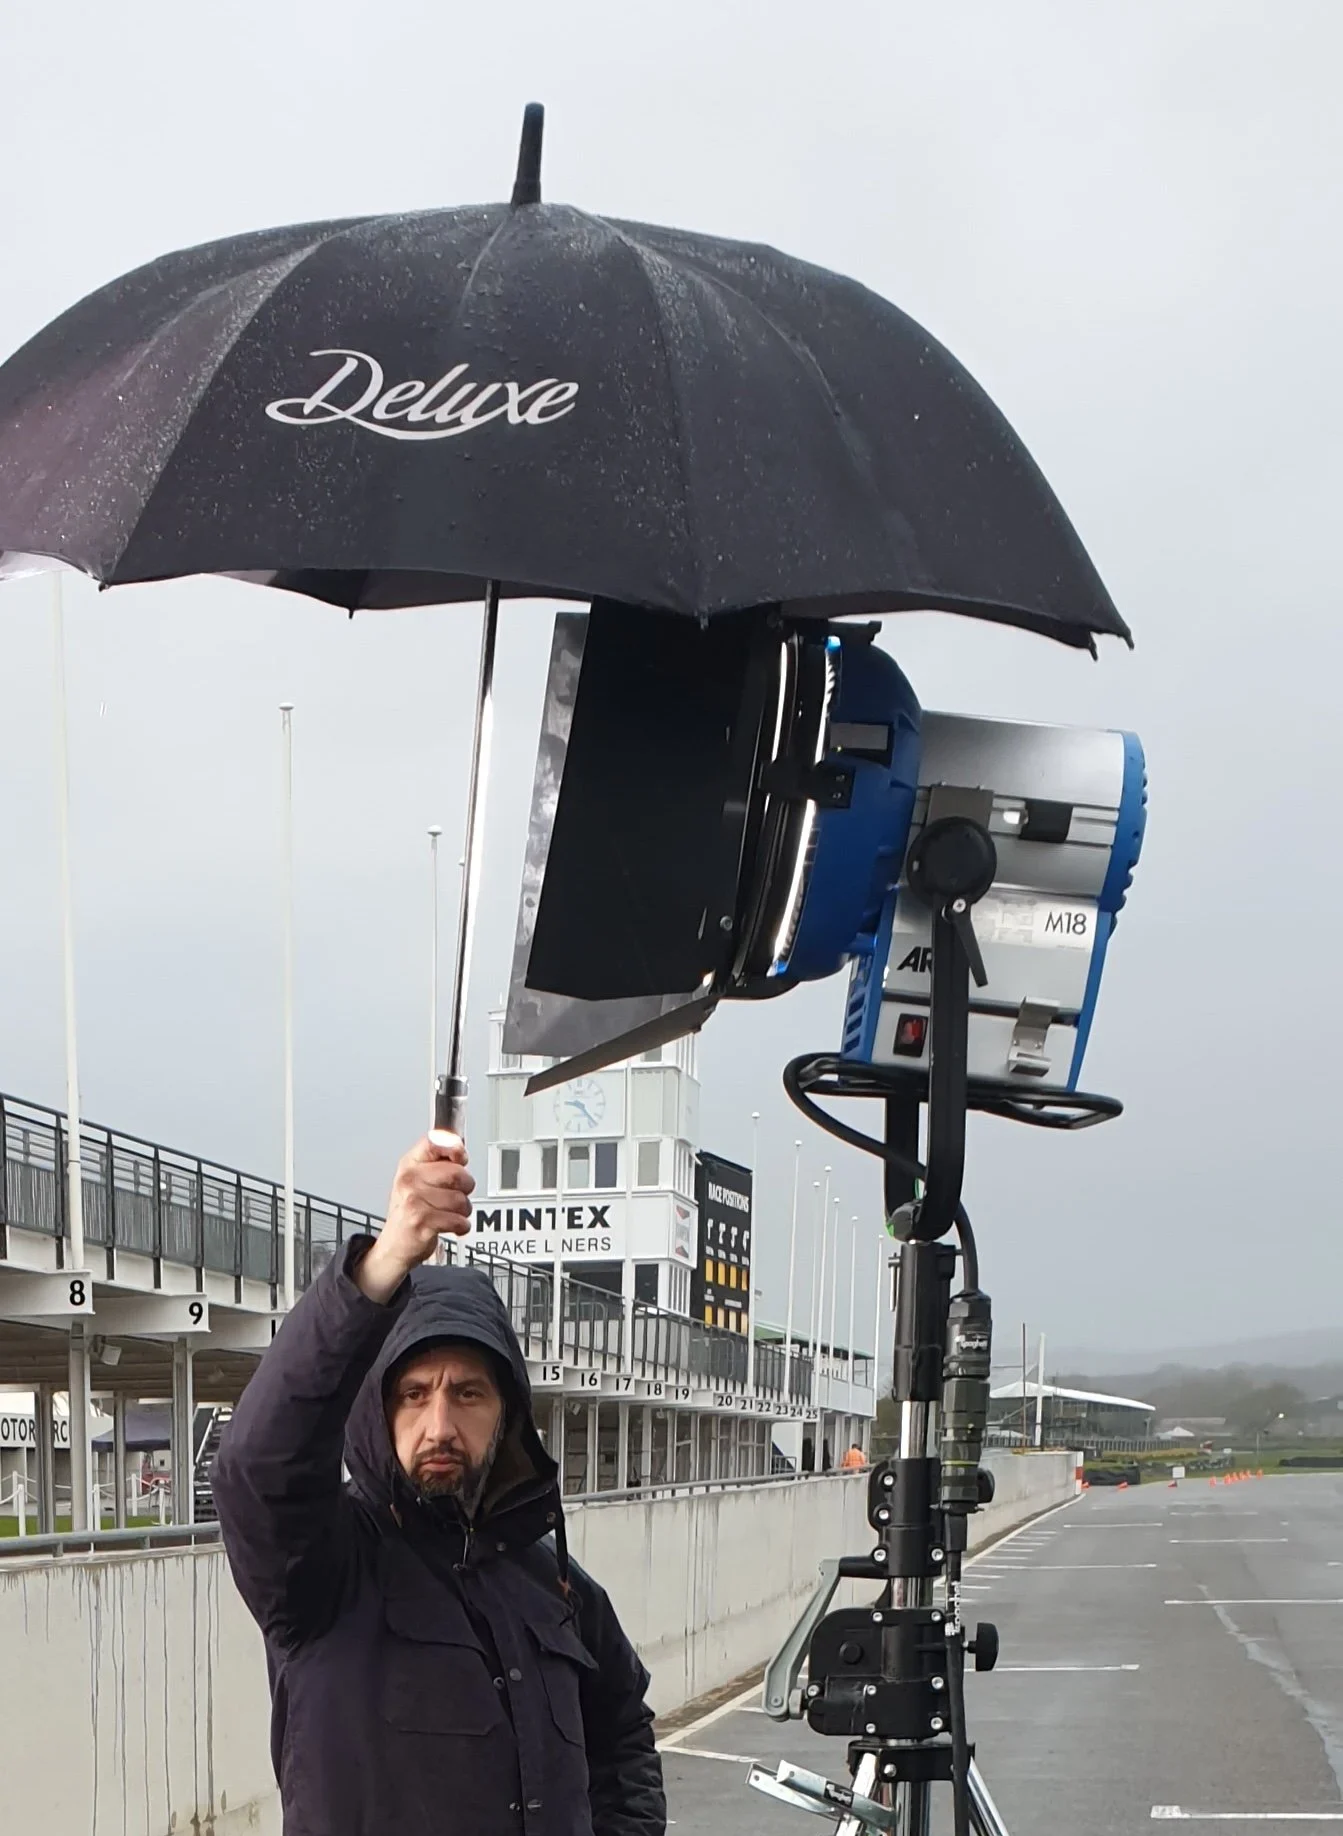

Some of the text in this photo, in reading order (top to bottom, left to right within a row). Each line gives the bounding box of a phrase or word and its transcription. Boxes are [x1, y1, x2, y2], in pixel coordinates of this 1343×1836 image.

[265, 348, 579, 440] Deluxe
[1044, 911, 1088, 936] M18
[896, 946, 932, 973] AR
[476, 1205, 611, 1232] MINTEX
[475, 1236, 612, 1255] BRAKE LNERS
[69, 1279, 86, 1306] 8
[188, 1301, 204, 1325] 9
[542, 1365, 560, 1381] 15
[581, 1372, 598, 1387] 16
[616, 1377, 632, 1391] 17
[647, 1383, 662, 1396] 18
[675, 1387, 690, 1400] 19
[717, 1395, 732, 1407] 20
[740, 1399, 753, 1410] 21
[758, 1402, 771, 1412] 22
[775, 1405, 788, 1415] 23
[790, 1407, 803, 1417] 24
[806, 1409, 818, 1419] 25
[1, 1417, 36, 1441] OTOR
